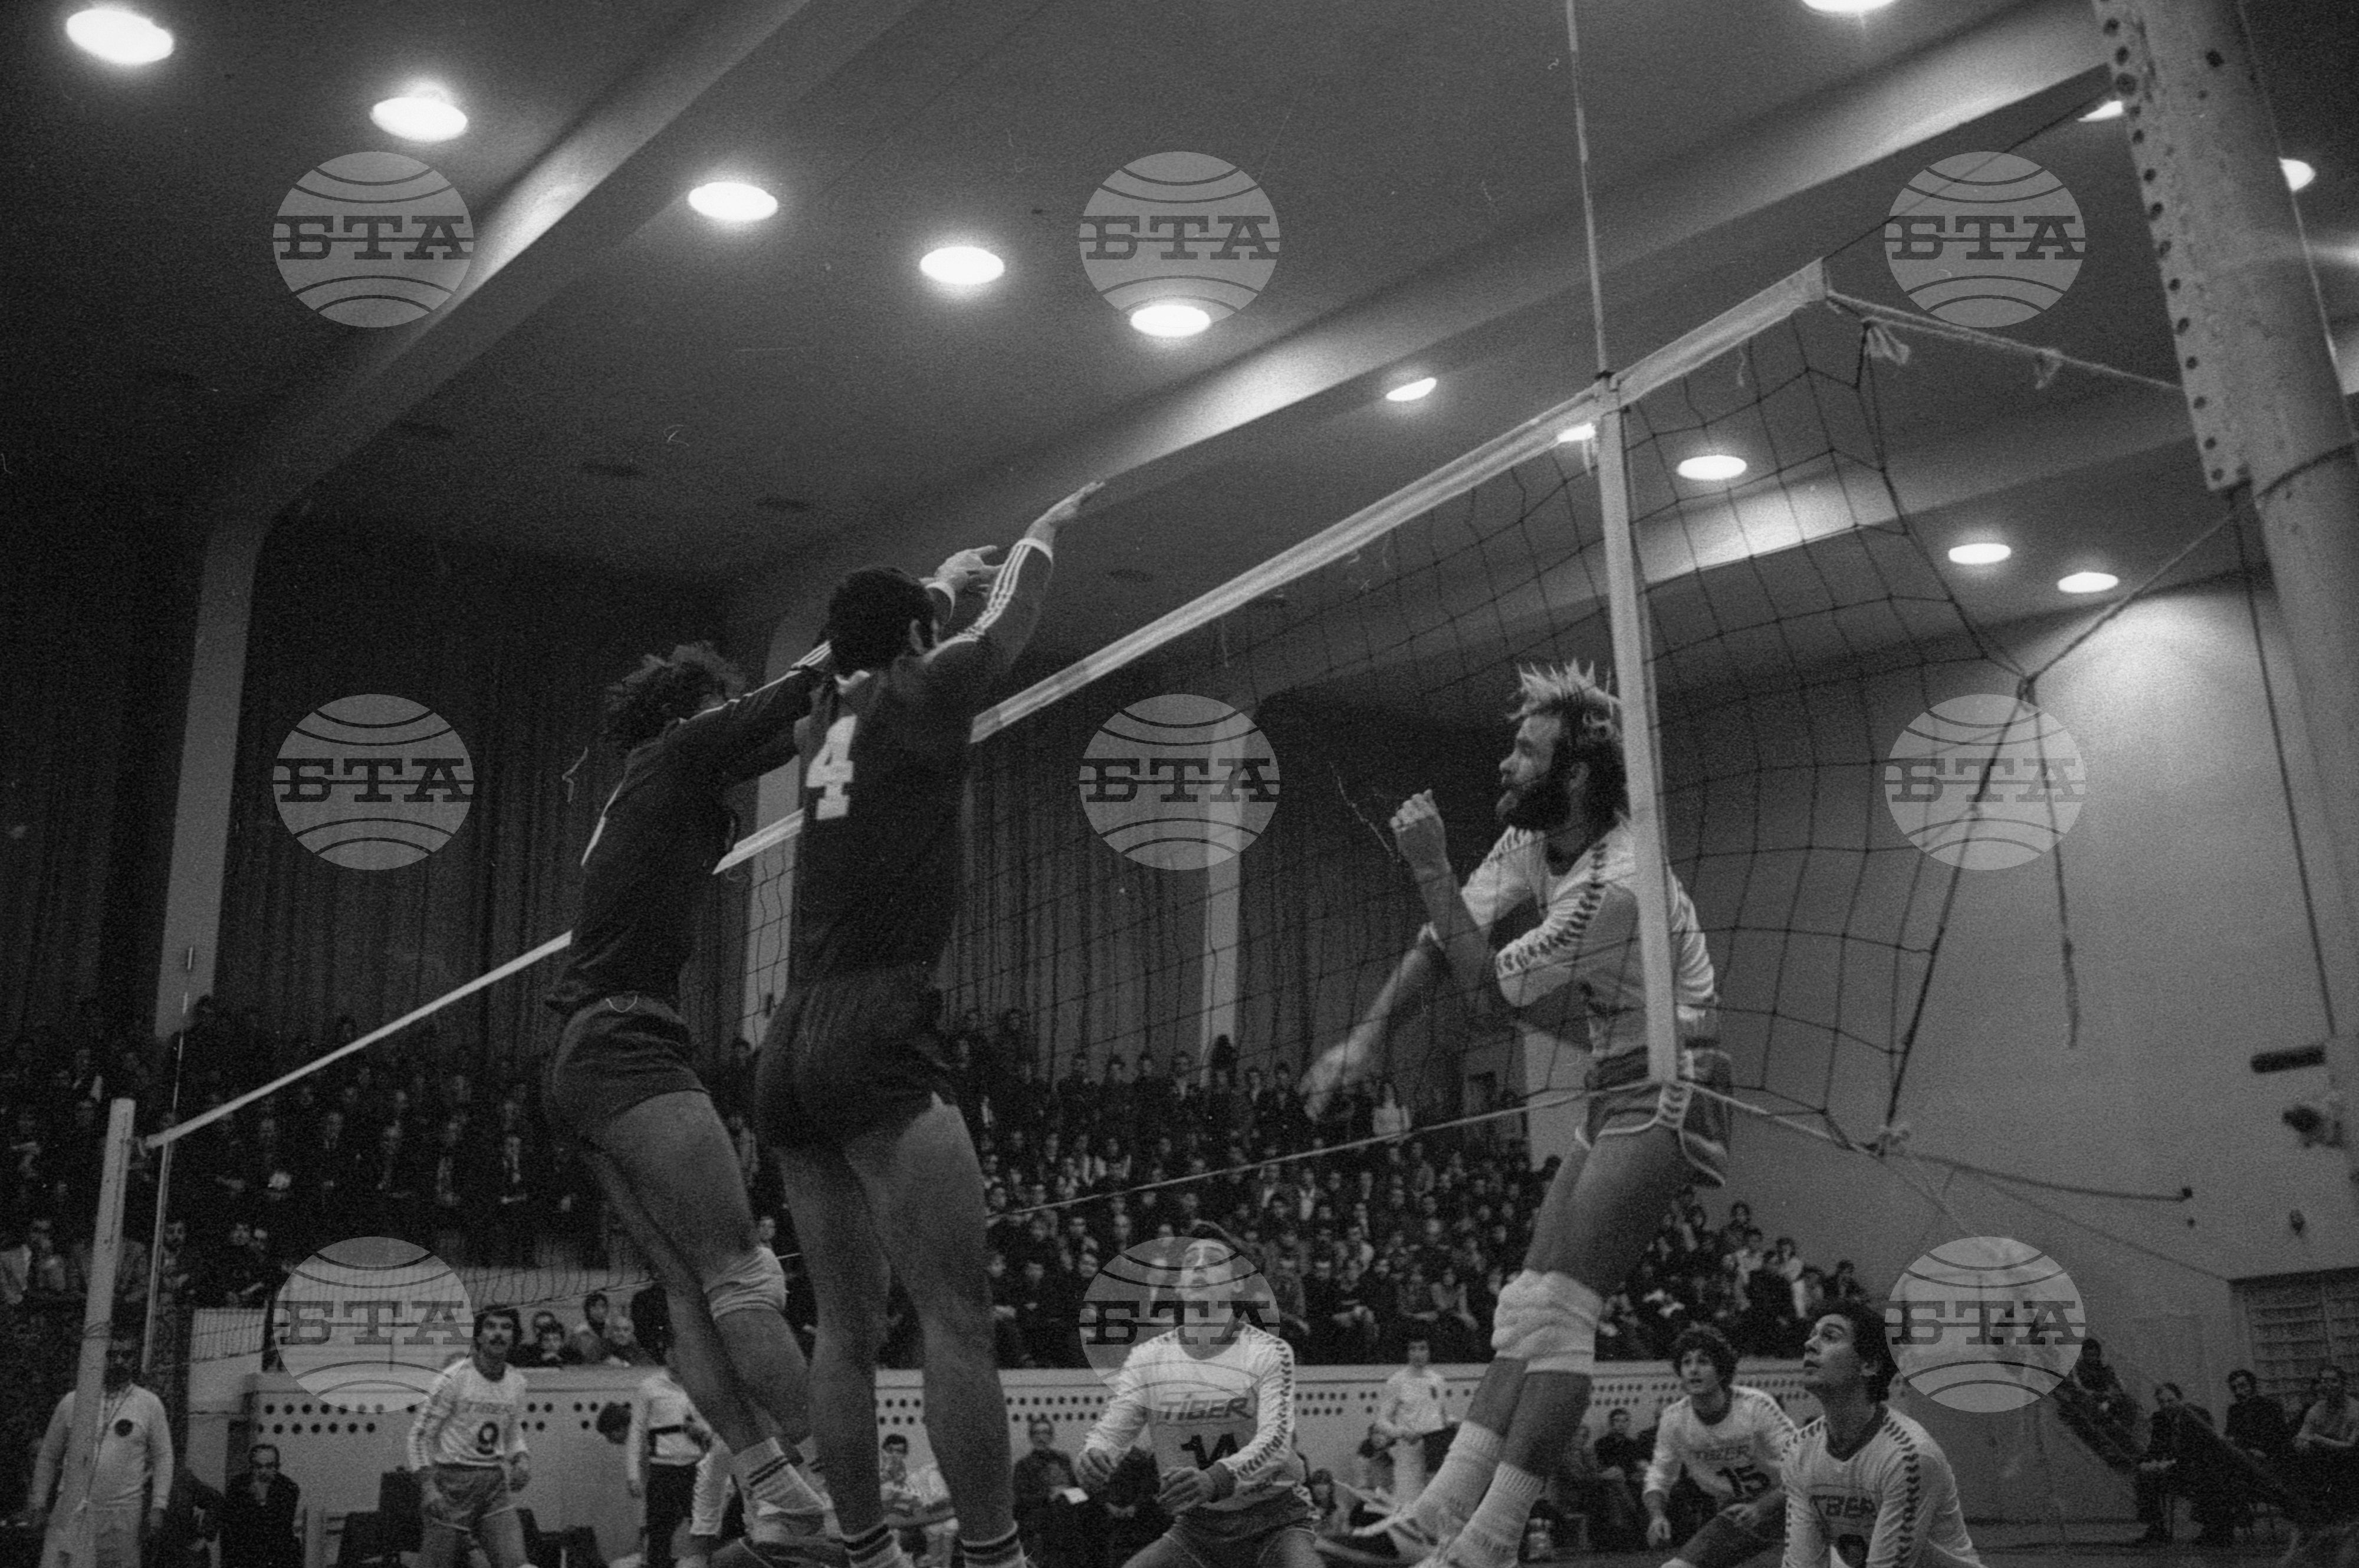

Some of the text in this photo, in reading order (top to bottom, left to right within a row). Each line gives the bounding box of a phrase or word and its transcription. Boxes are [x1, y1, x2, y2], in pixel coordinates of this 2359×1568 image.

[806, 714, 856, 820] 4
[475, 1421, 499, 1455] 9
[1716, 1464, 1771, 1497] 15
